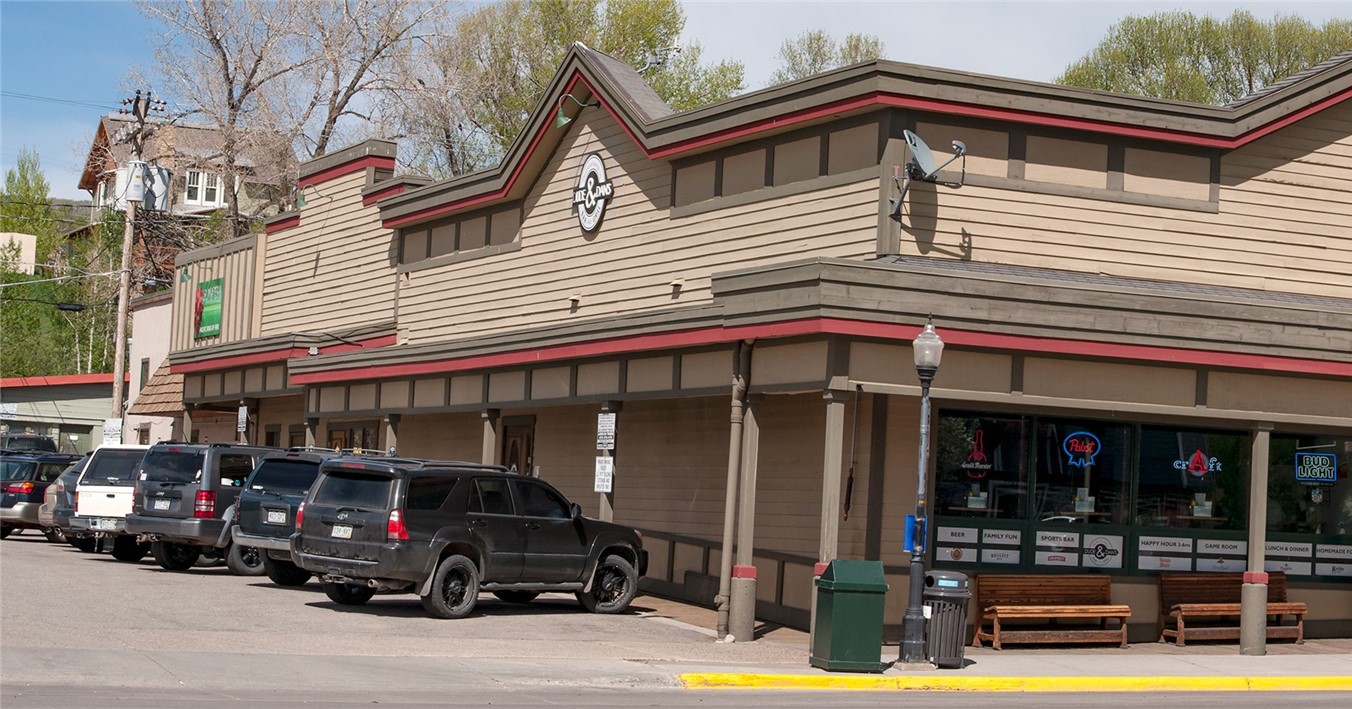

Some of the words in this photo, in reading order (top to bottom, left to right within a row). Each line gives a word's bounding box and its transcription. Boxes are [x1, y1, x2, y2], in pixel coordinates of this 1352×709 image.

[585, 178, 596, 208] &
[1069, 439, 1095, 453] Pabst
[1302, 455, 1330, 467] BUD
[1298, 466, 1334, 479] LIGHT
[1096, 545, 1104, 557] &
